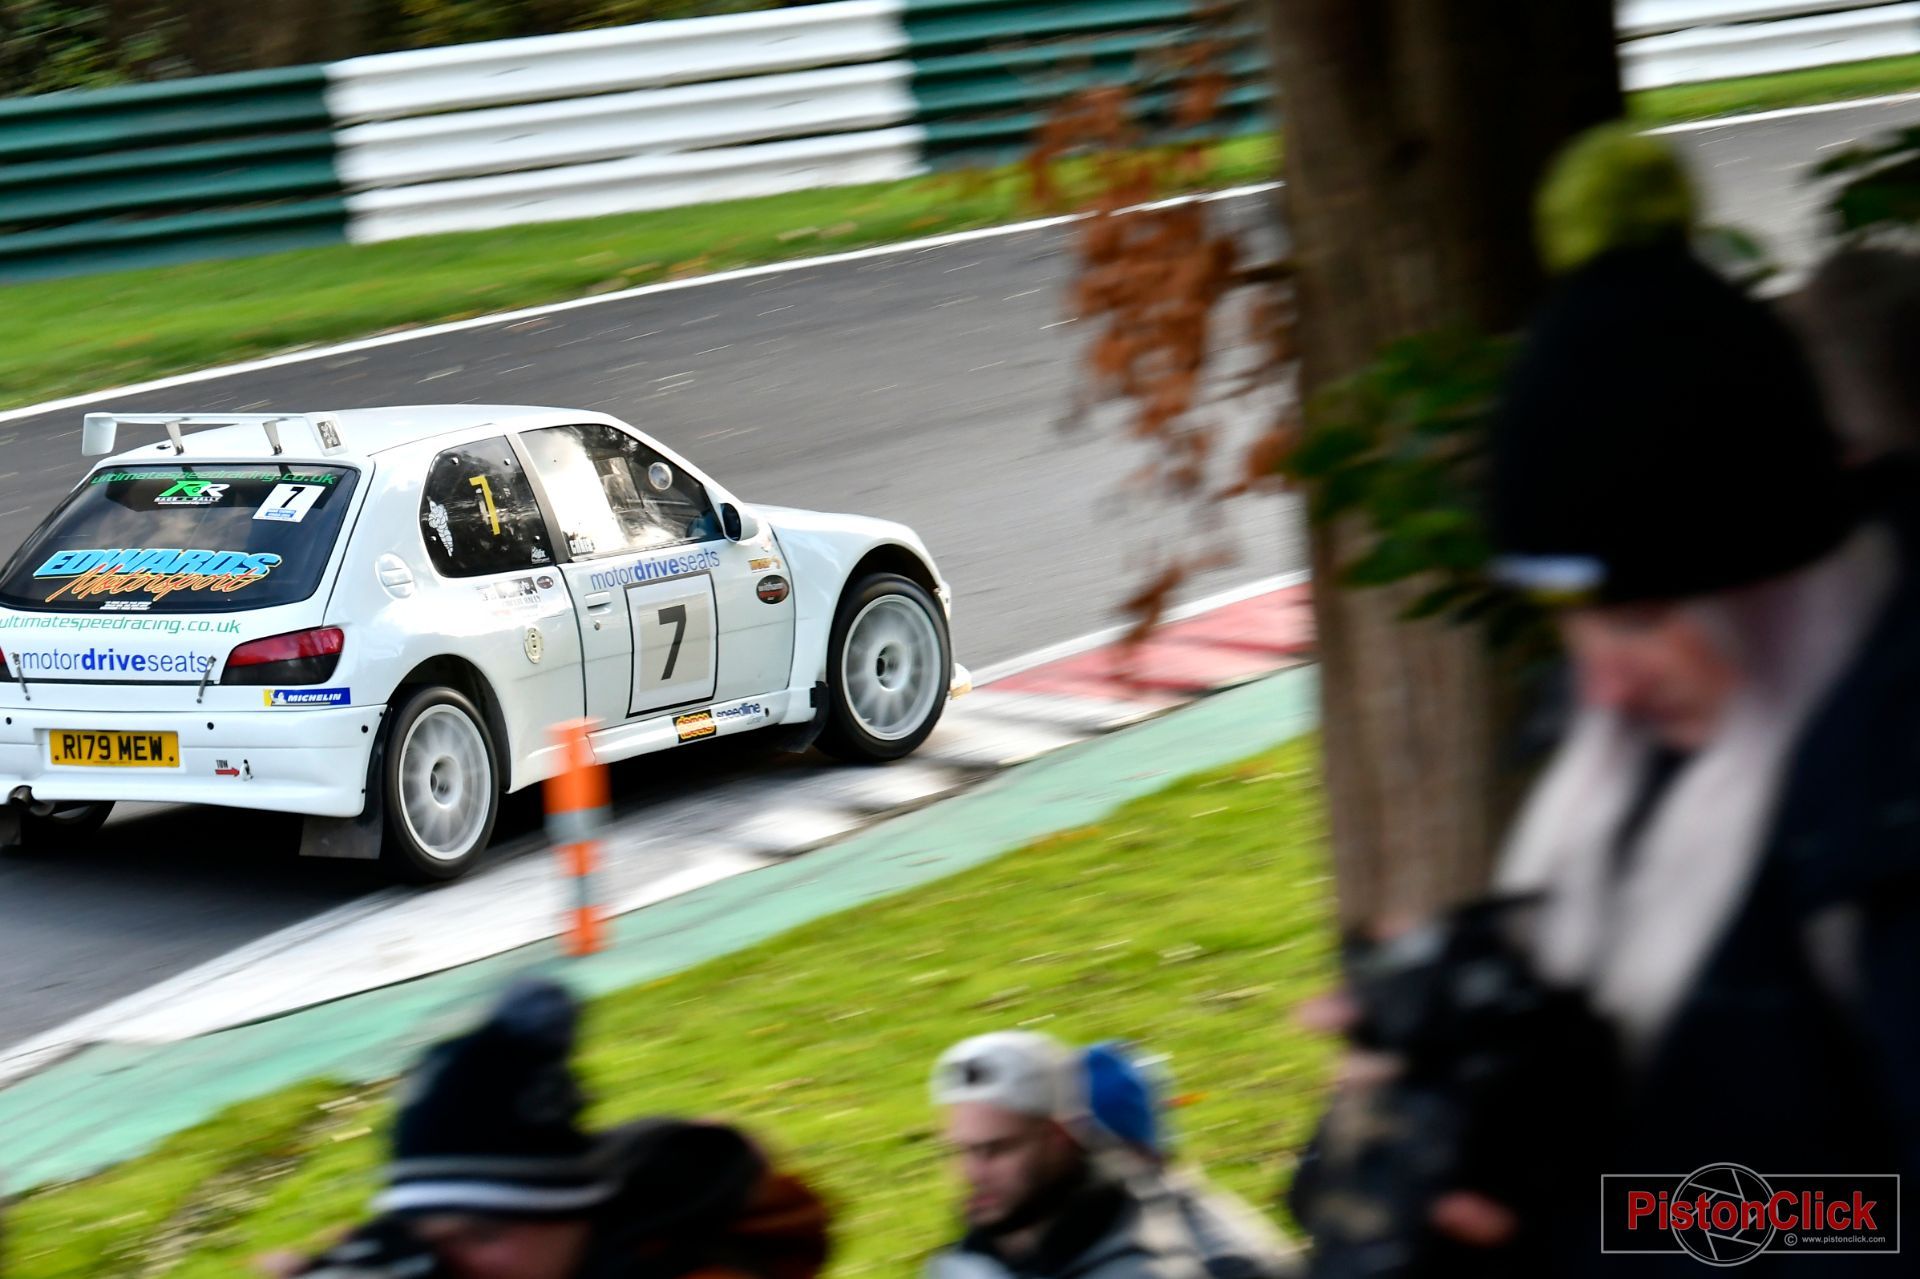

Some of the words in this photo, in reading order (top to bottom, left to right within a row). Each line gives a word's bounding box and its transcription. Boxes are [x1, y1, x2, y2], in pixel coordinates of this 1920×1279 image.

[91, 470, 337, 485] ultimatespeedracing.co.uk
[280, 486, 306, 509] 7
[33, 549, 283, 579] EDWARDS
[590, 548, 720, 591] motordriveseats
[45, 562, 255, 603] Motorsport
[0, 614, 242, 634] ultimatespeedracing.co.uk
[658, 604, 687, 681] 7
[22, 647, 210, 673] motordriveseats
[287, 692, 342, 703] MICHELIN
[62, 734, 111, 760] R179
[117, 735, 163, 761] MEW
